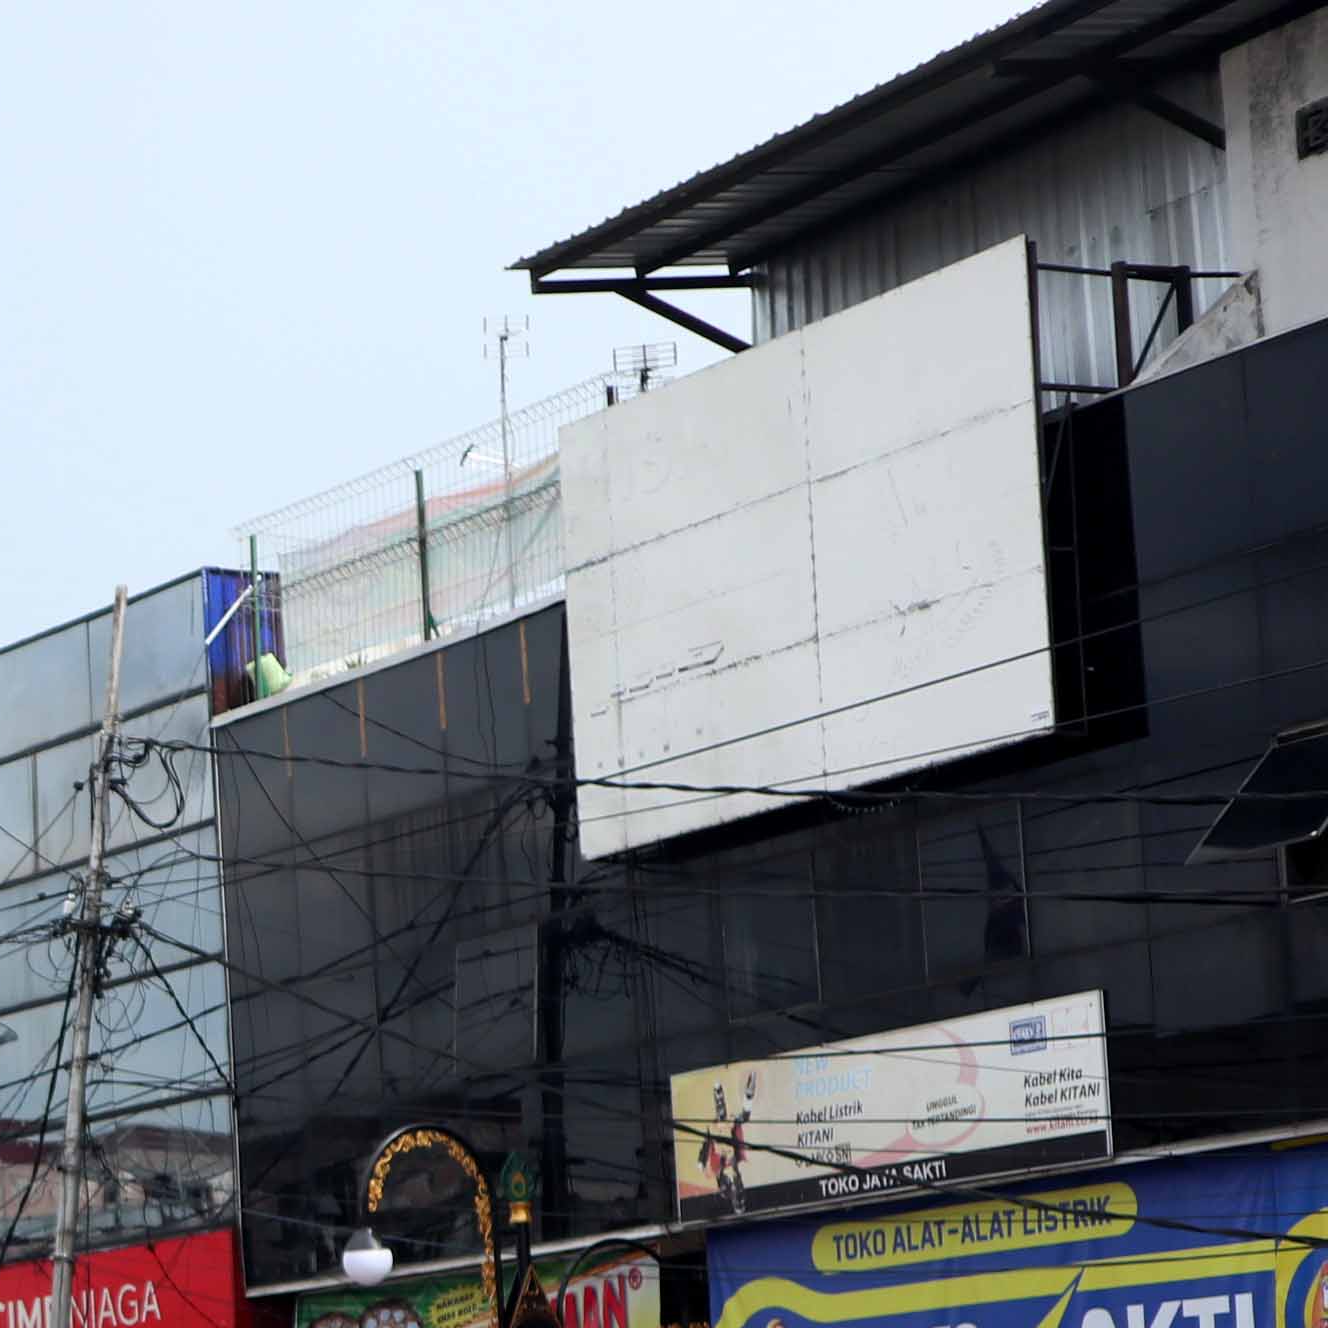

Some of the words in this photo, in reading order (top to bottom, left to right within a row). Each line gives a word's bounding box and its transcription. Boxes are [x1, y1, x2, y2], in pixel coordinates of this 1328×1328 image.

[1025, 1090, 1058, 1108] Kabel
[1059, 1082, 1101, 1102] KITANI
[829, 1100, 864, 1120] Listrik
[797, 1127, 835, 1147] KITANI
[819, 1175, 860, 1197] TOKO
[833, 1229, 887, 1263] TOKO
[892, 1209, 1016, 1255] ALAT-ALAT
[1021, 1194, 1113, 1236] LISTRIK
